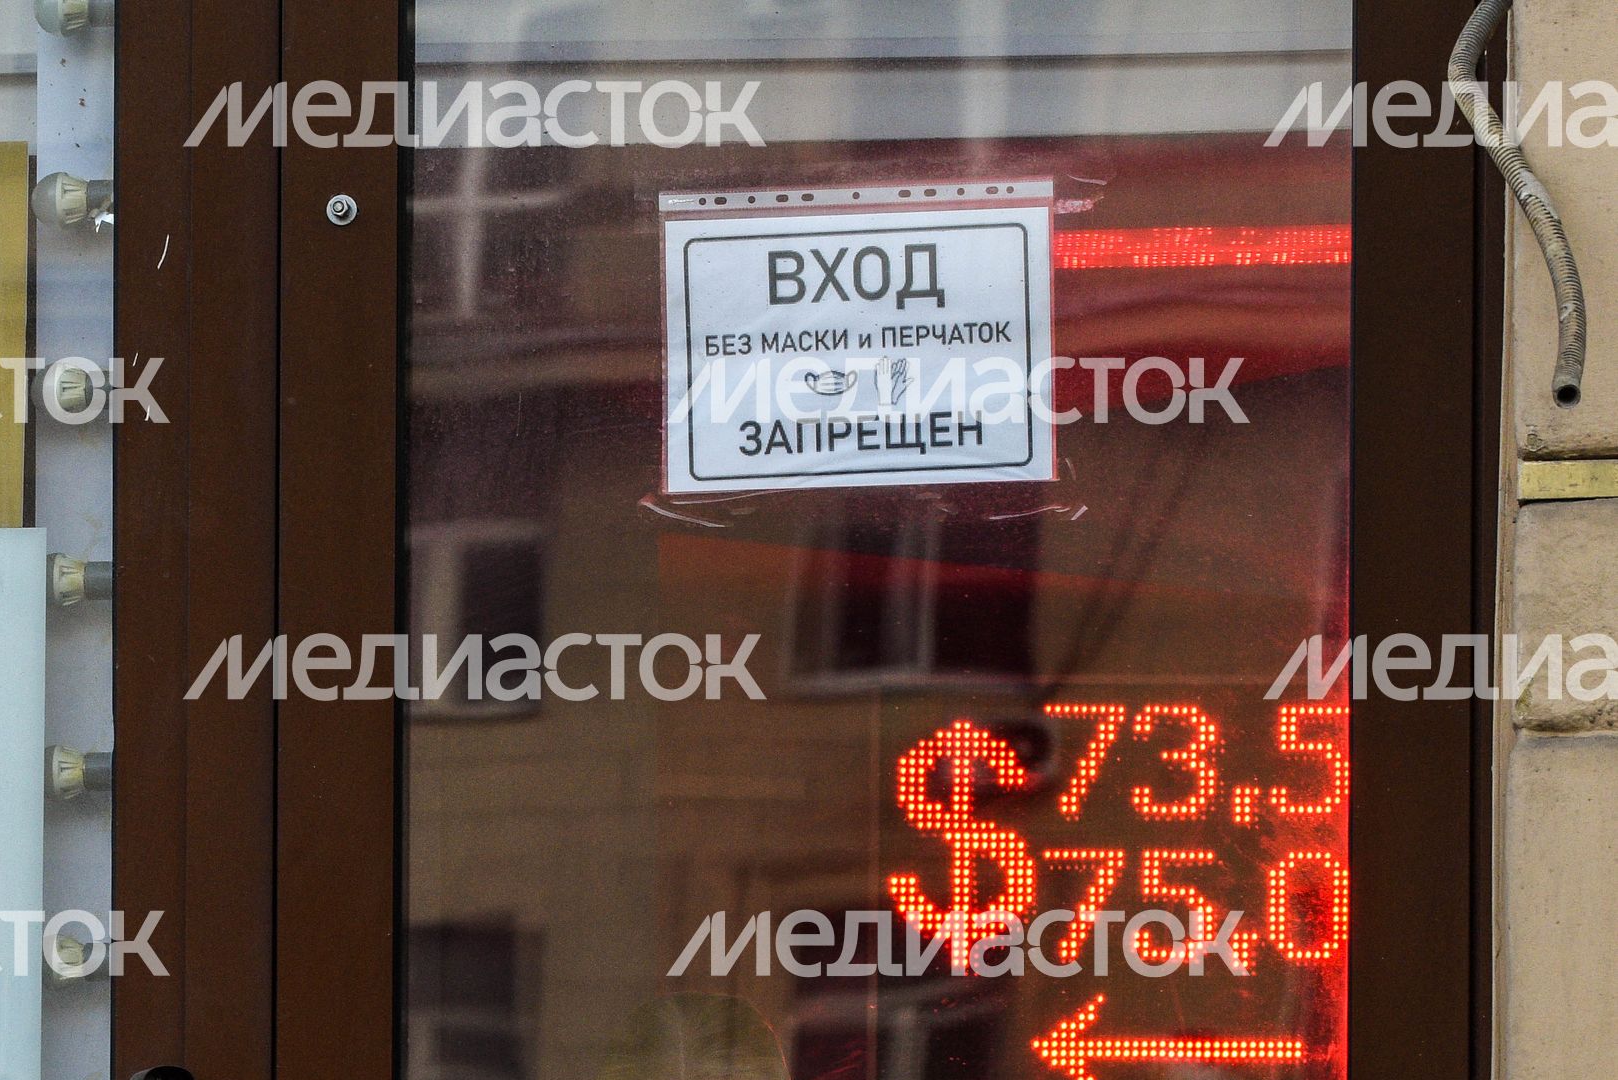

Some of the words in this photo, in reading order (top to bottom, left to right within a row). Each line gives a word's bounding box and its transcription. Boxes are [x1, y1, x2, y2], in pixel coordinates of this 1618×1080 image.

[767, 243, 945, 310] ВХОД
[705, 332, 752, 357] БЕЗ
[761, 328, 849, 354] МАСКИ
[881, 321, 1012, 349] ПЕРЧАТОК
[739, 410, 983, 456] ЗАПРЕЩЕН
[888, 719, 1037, 973] $
